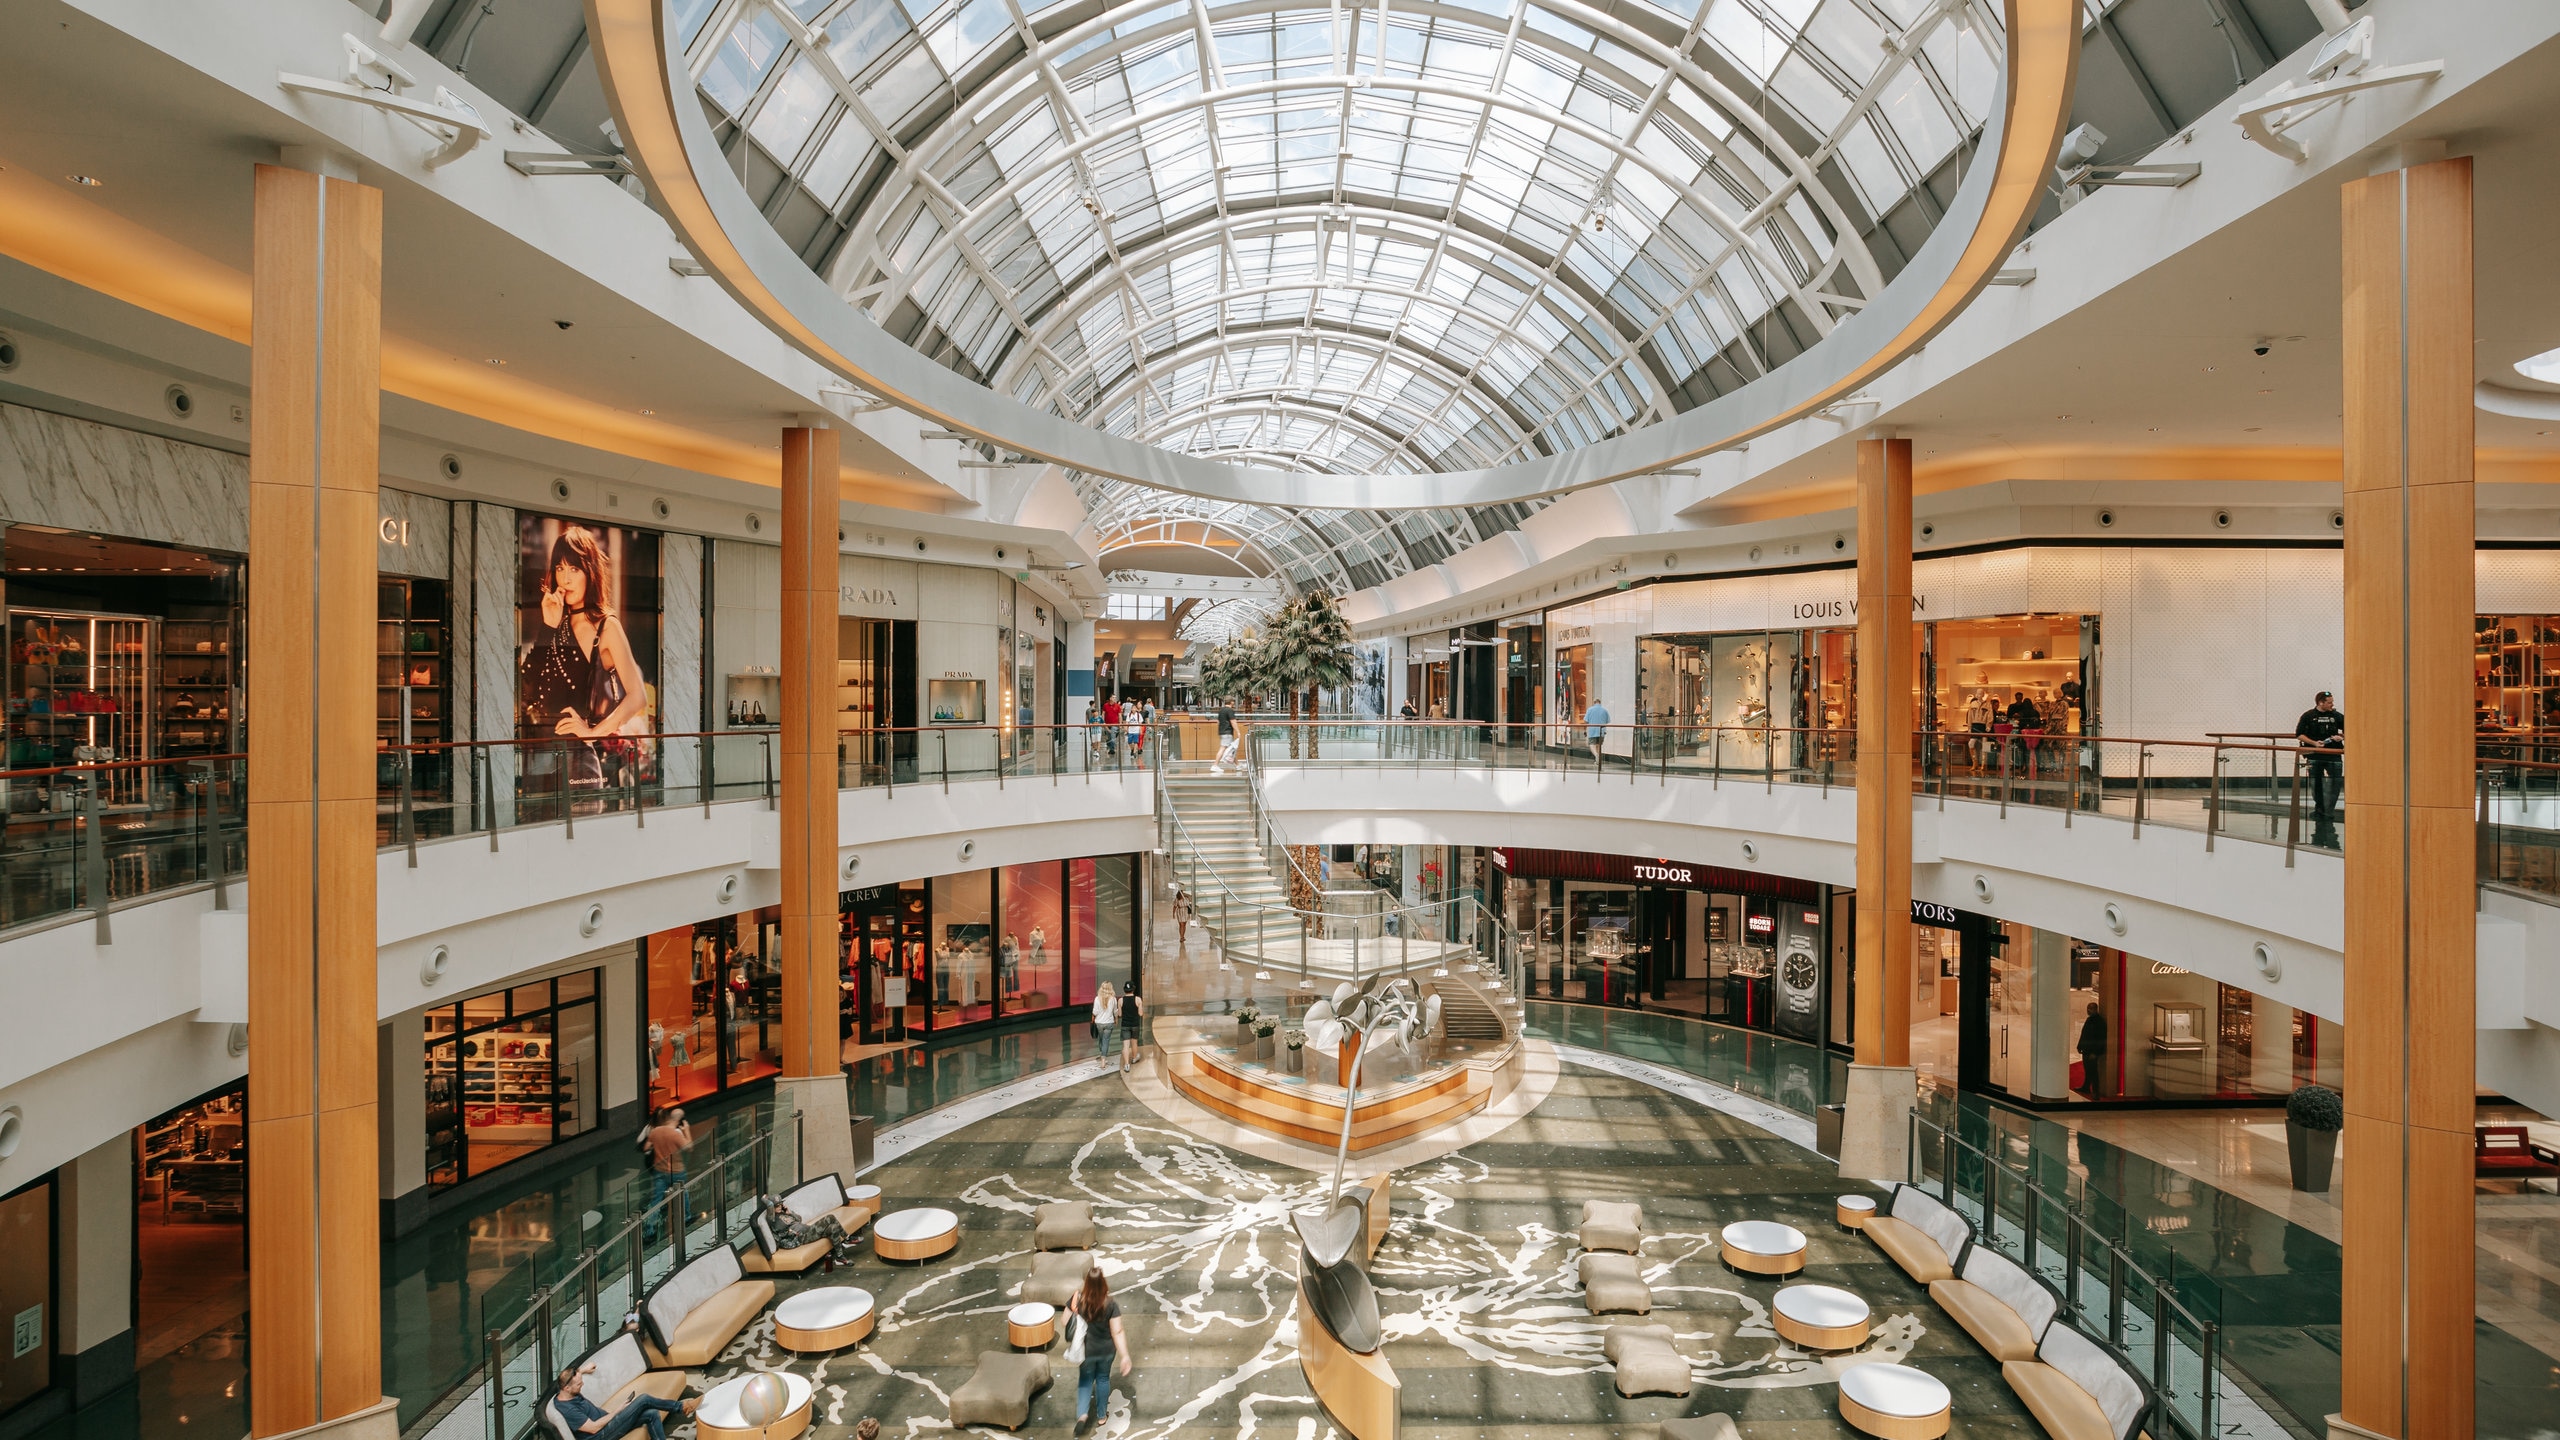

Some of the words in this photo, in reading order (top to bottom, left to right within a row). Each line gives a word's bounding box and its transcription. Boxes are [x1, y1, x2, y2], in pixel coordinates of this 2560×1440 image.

[839, 585, 897, 606] RADA
[1794, 601, 1842, 619] LOUIS
[1633, 865, 1693, 883] TUDOR
[839, 887, 882, 909] J.CREW
